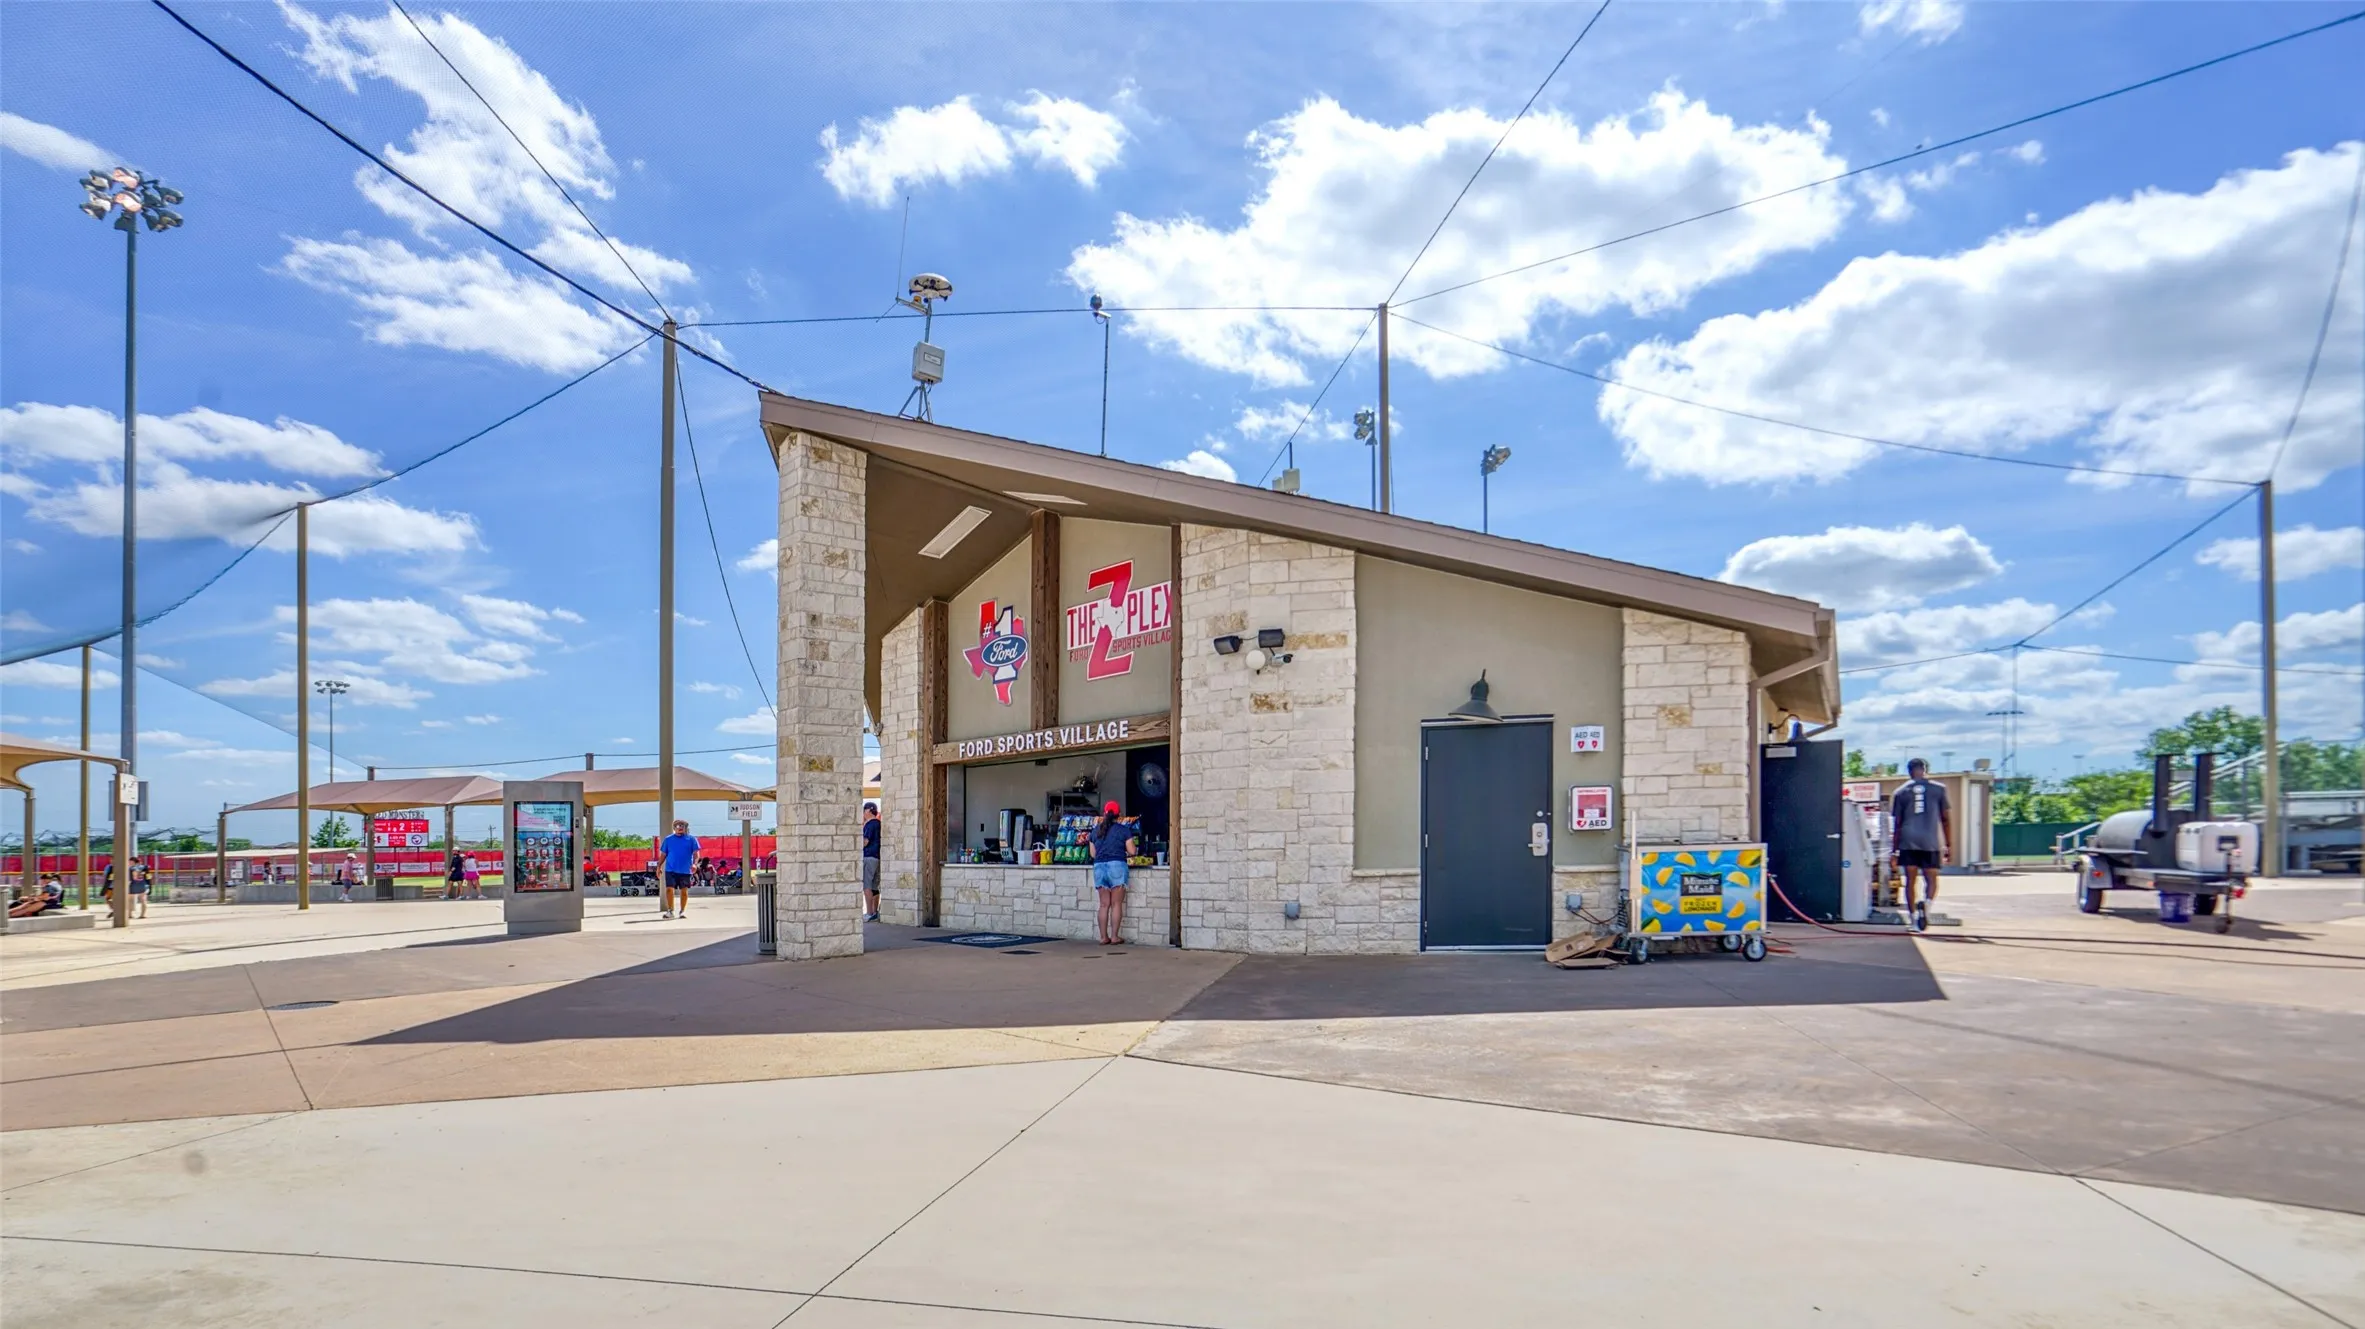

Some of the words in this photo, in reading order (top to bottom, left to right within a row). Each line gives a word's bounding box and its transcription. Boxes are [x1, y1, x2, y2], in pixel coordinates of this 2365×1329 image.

[1067, 603, 1098, 648] THE
[1127, 584, 1171, 635] PLEX
[989, 639, 1019, 662] Ford
[1112, 636, 1141, 653] SPORTS
[1143, 629, 1171, 645] VILLAG
[959, 739, 993, 758] FORD
[997, 731, 1054, 753] SPORTS
[1059, 720, 1129, 745] VILLAGE
[1575, 731, 1588, 739] AED
[1588, 819, 1607, 827] AED
